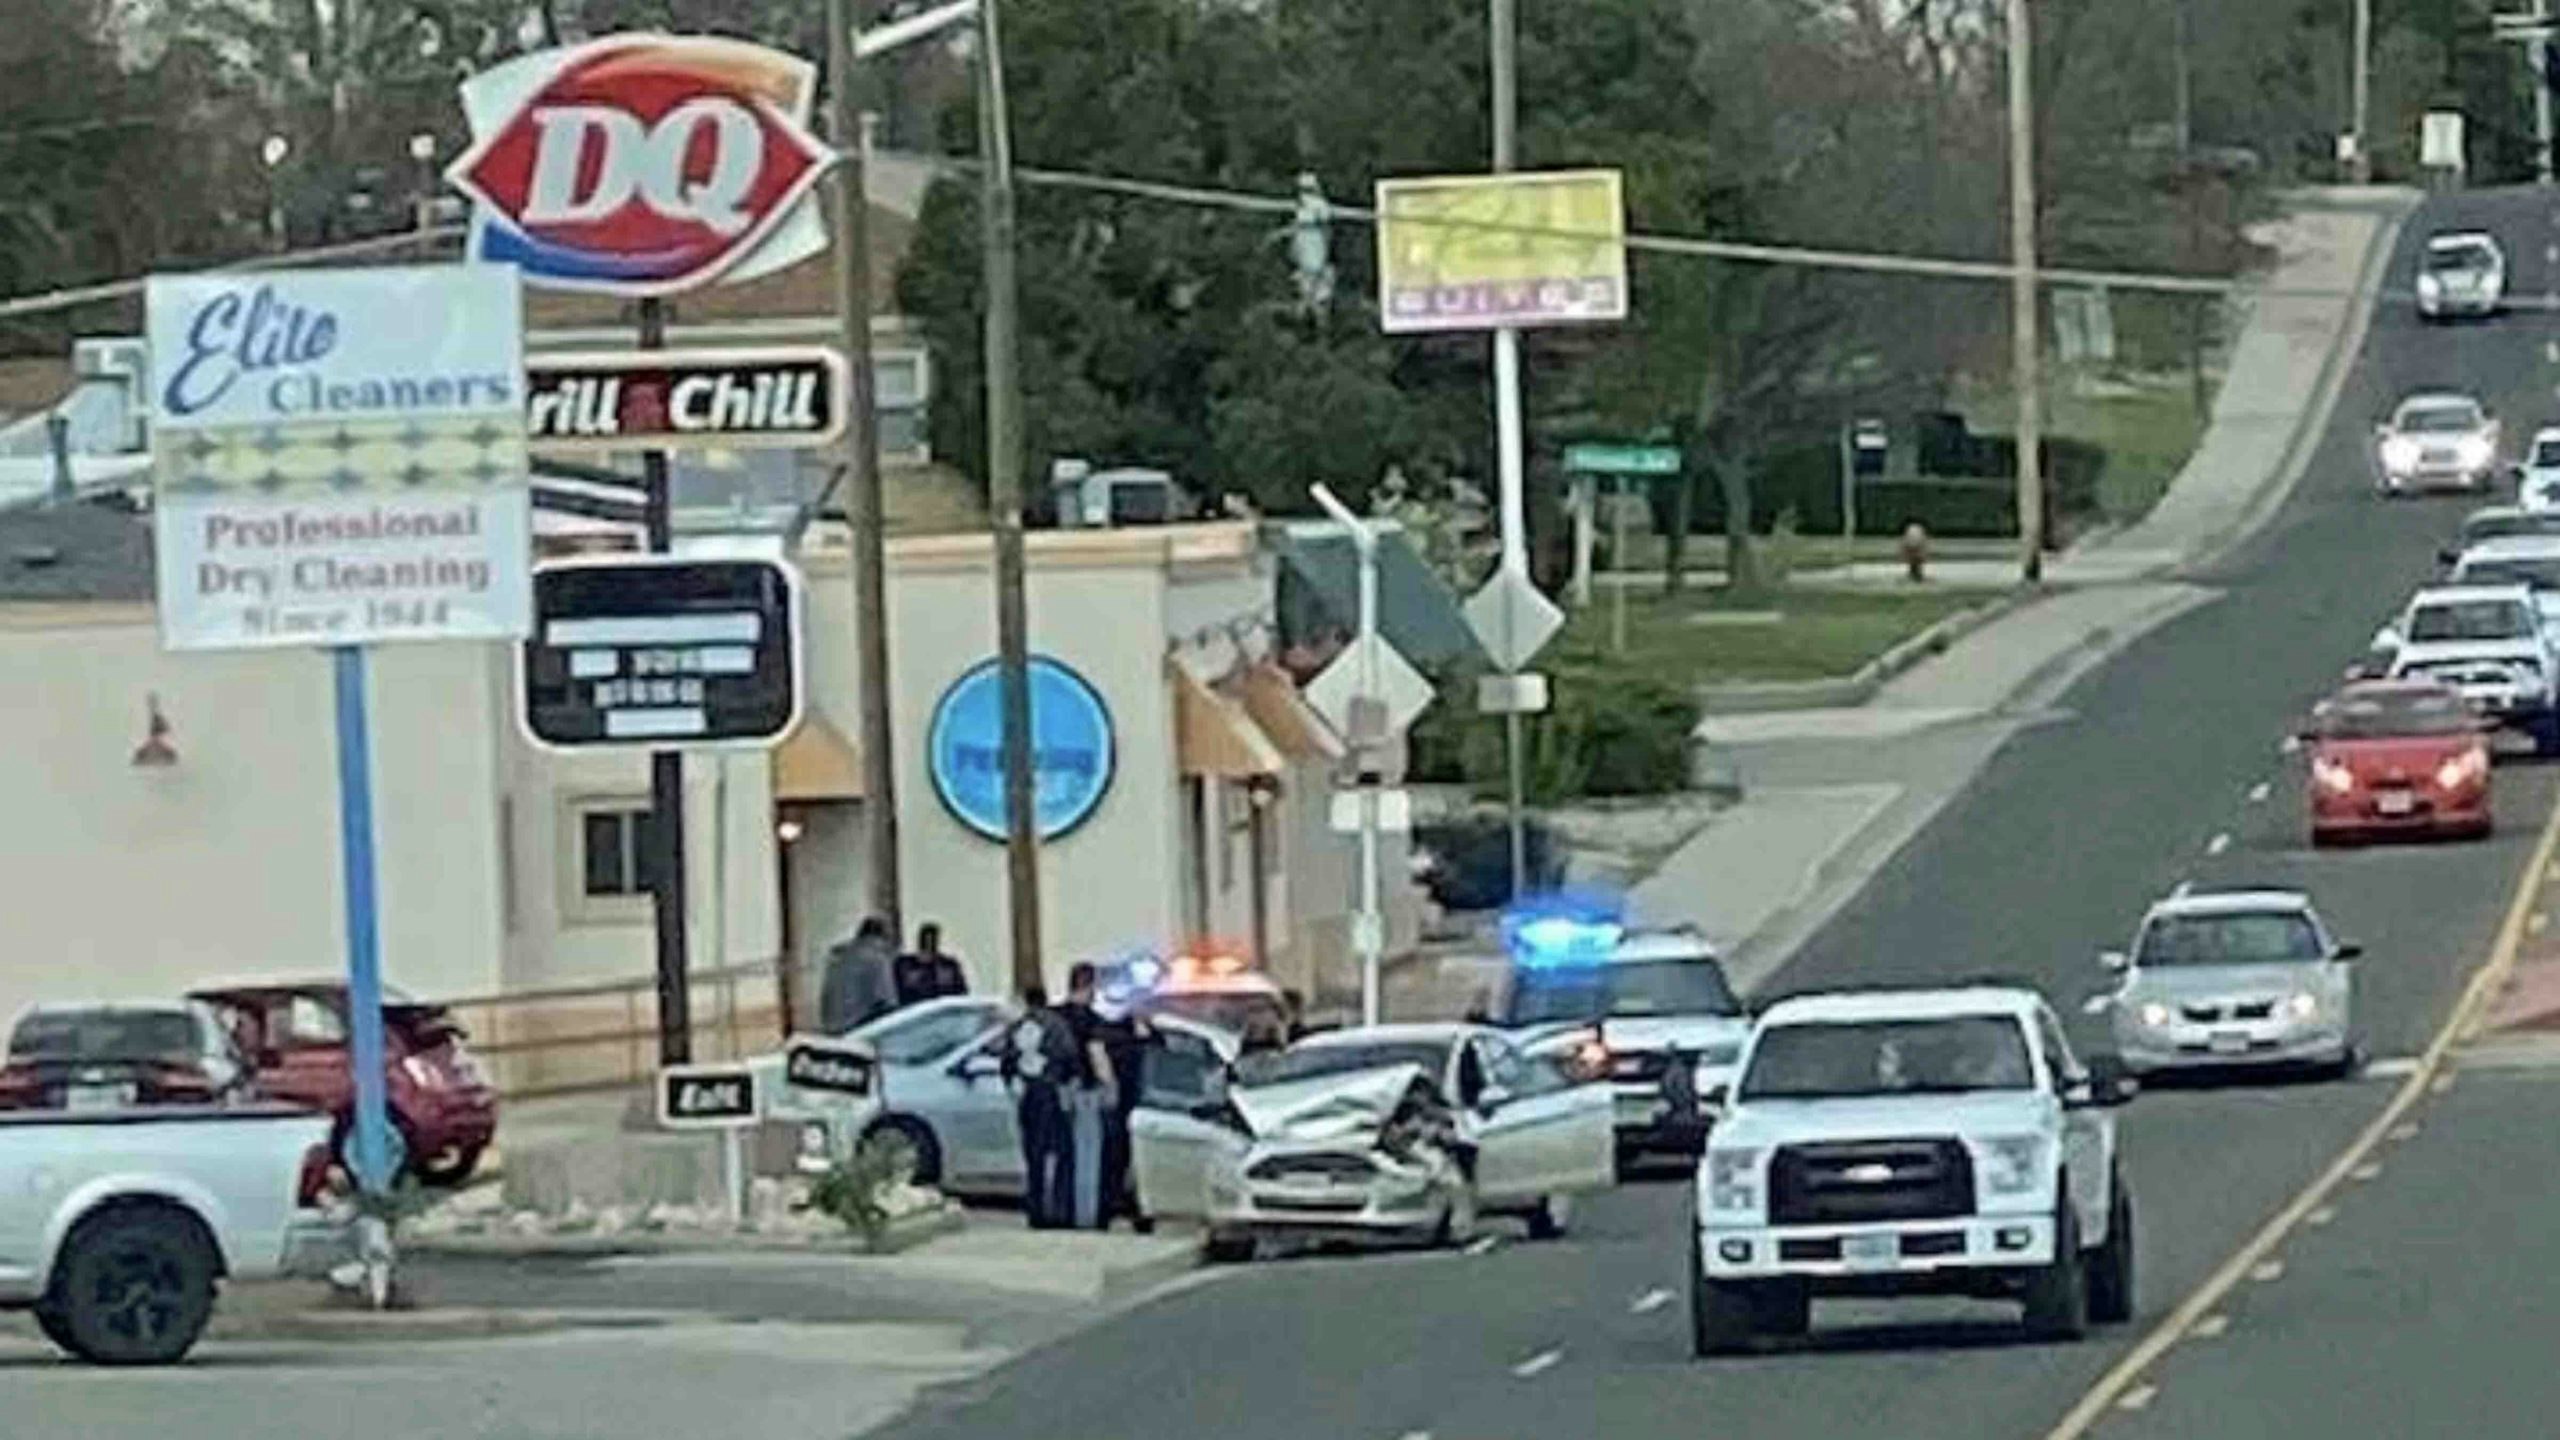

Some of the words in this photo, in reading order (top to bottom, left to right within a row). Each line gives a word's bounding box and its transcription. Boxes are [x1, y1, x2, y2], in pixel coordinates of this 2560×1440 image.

[520, 94, 764, 236] DQ
[163, 283, 338, 415] Elite
[267, 369, 514, 414] Cleaners
[528, 376, 622, 434] rill
[667, 368, 820, 430] Chill
[204, 505, 479, 549] Professional
[197, 560, 274, 595] Dry
[292, 553, 490, 592] Cleaning
